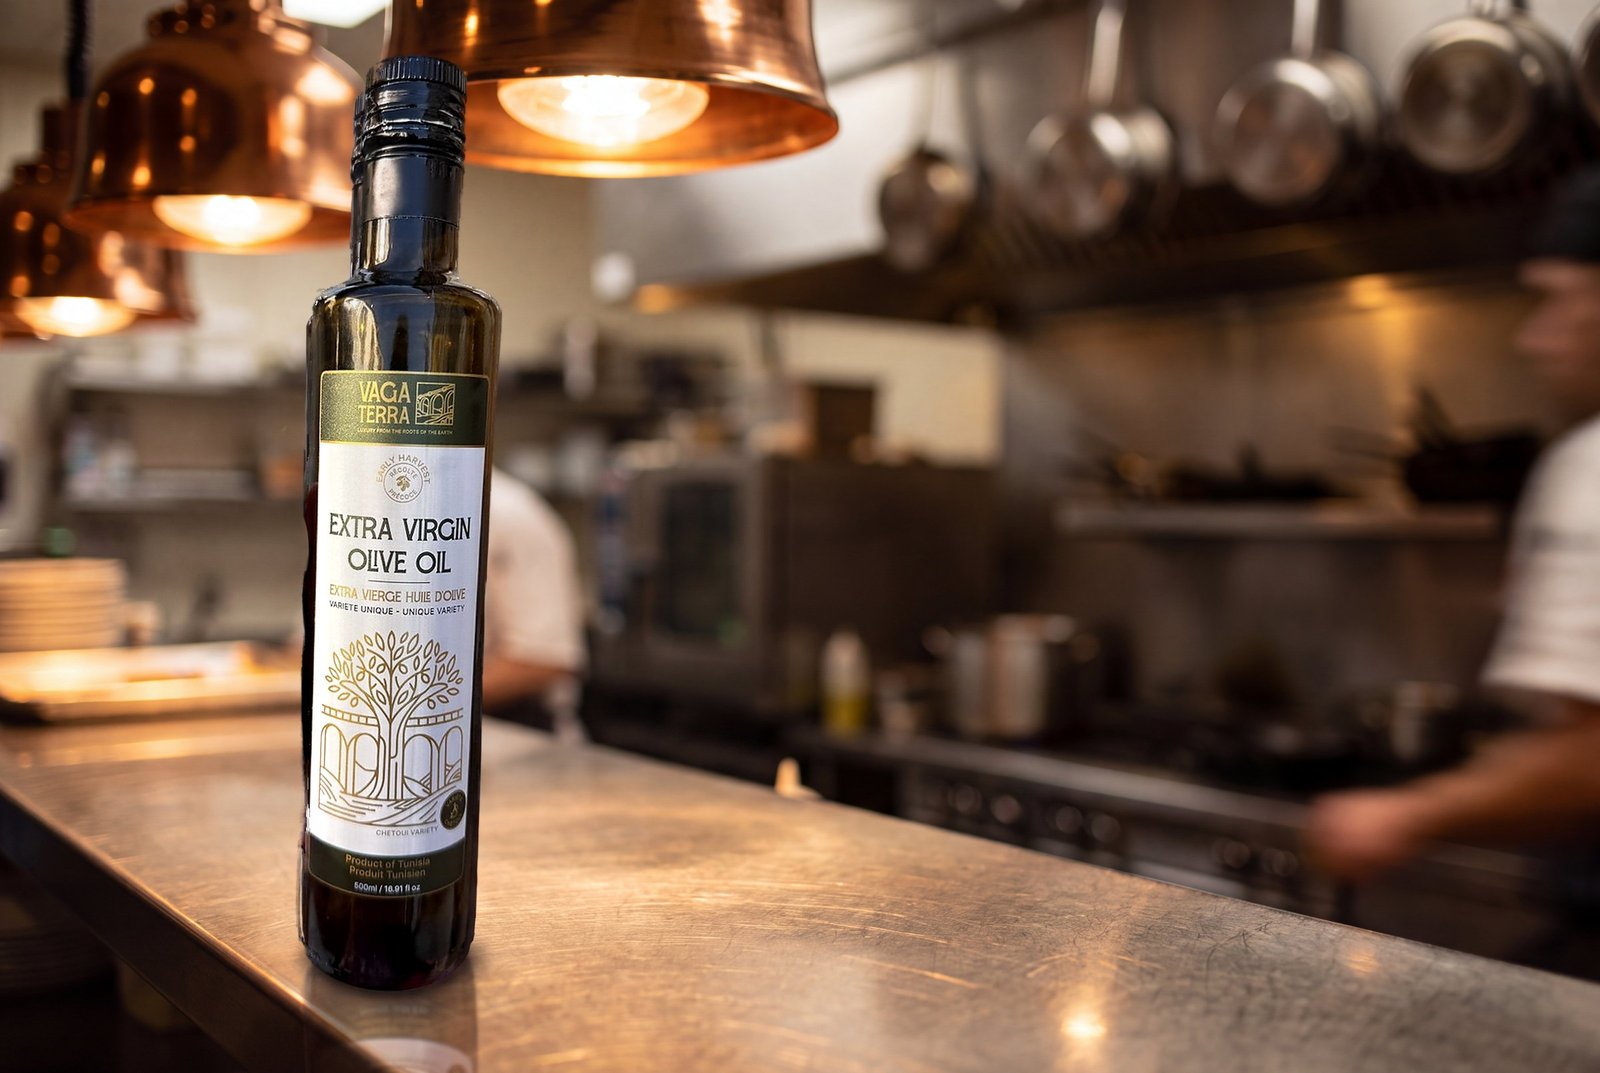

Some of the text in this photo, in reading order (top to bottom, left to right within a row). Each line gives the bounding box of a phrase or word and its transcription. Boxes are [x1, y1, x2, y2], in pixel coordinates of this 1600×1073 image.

[358, 381, 411, 403] VAGA
[357, 405, 411, 424] TERRA
[376, 454, 431, 484] EARLY HARVEST
[329, 512, 471, 541] EXTRA VIRGIN
[348, 548, 451, 574] OLIVE OIL
[329, 584, 466, 603] EXTRA VIERGE HUILE D'OLIVE
[329, 600, 359, 612] VARIETE
[360, 605, 394, 615] UNIQUE
[402, 607, 435, 616] UNIQUE
[437, 604, 466, 615] VARIETY
[410, 825, 439, 836] VARIETY
[345, 853, 431, 869] Product of Tunisia
[349, 865, 426, 879] Produit Tunisien
[354, 881, 378, 892] 500ml
[405, 884, 410, 892] fl
